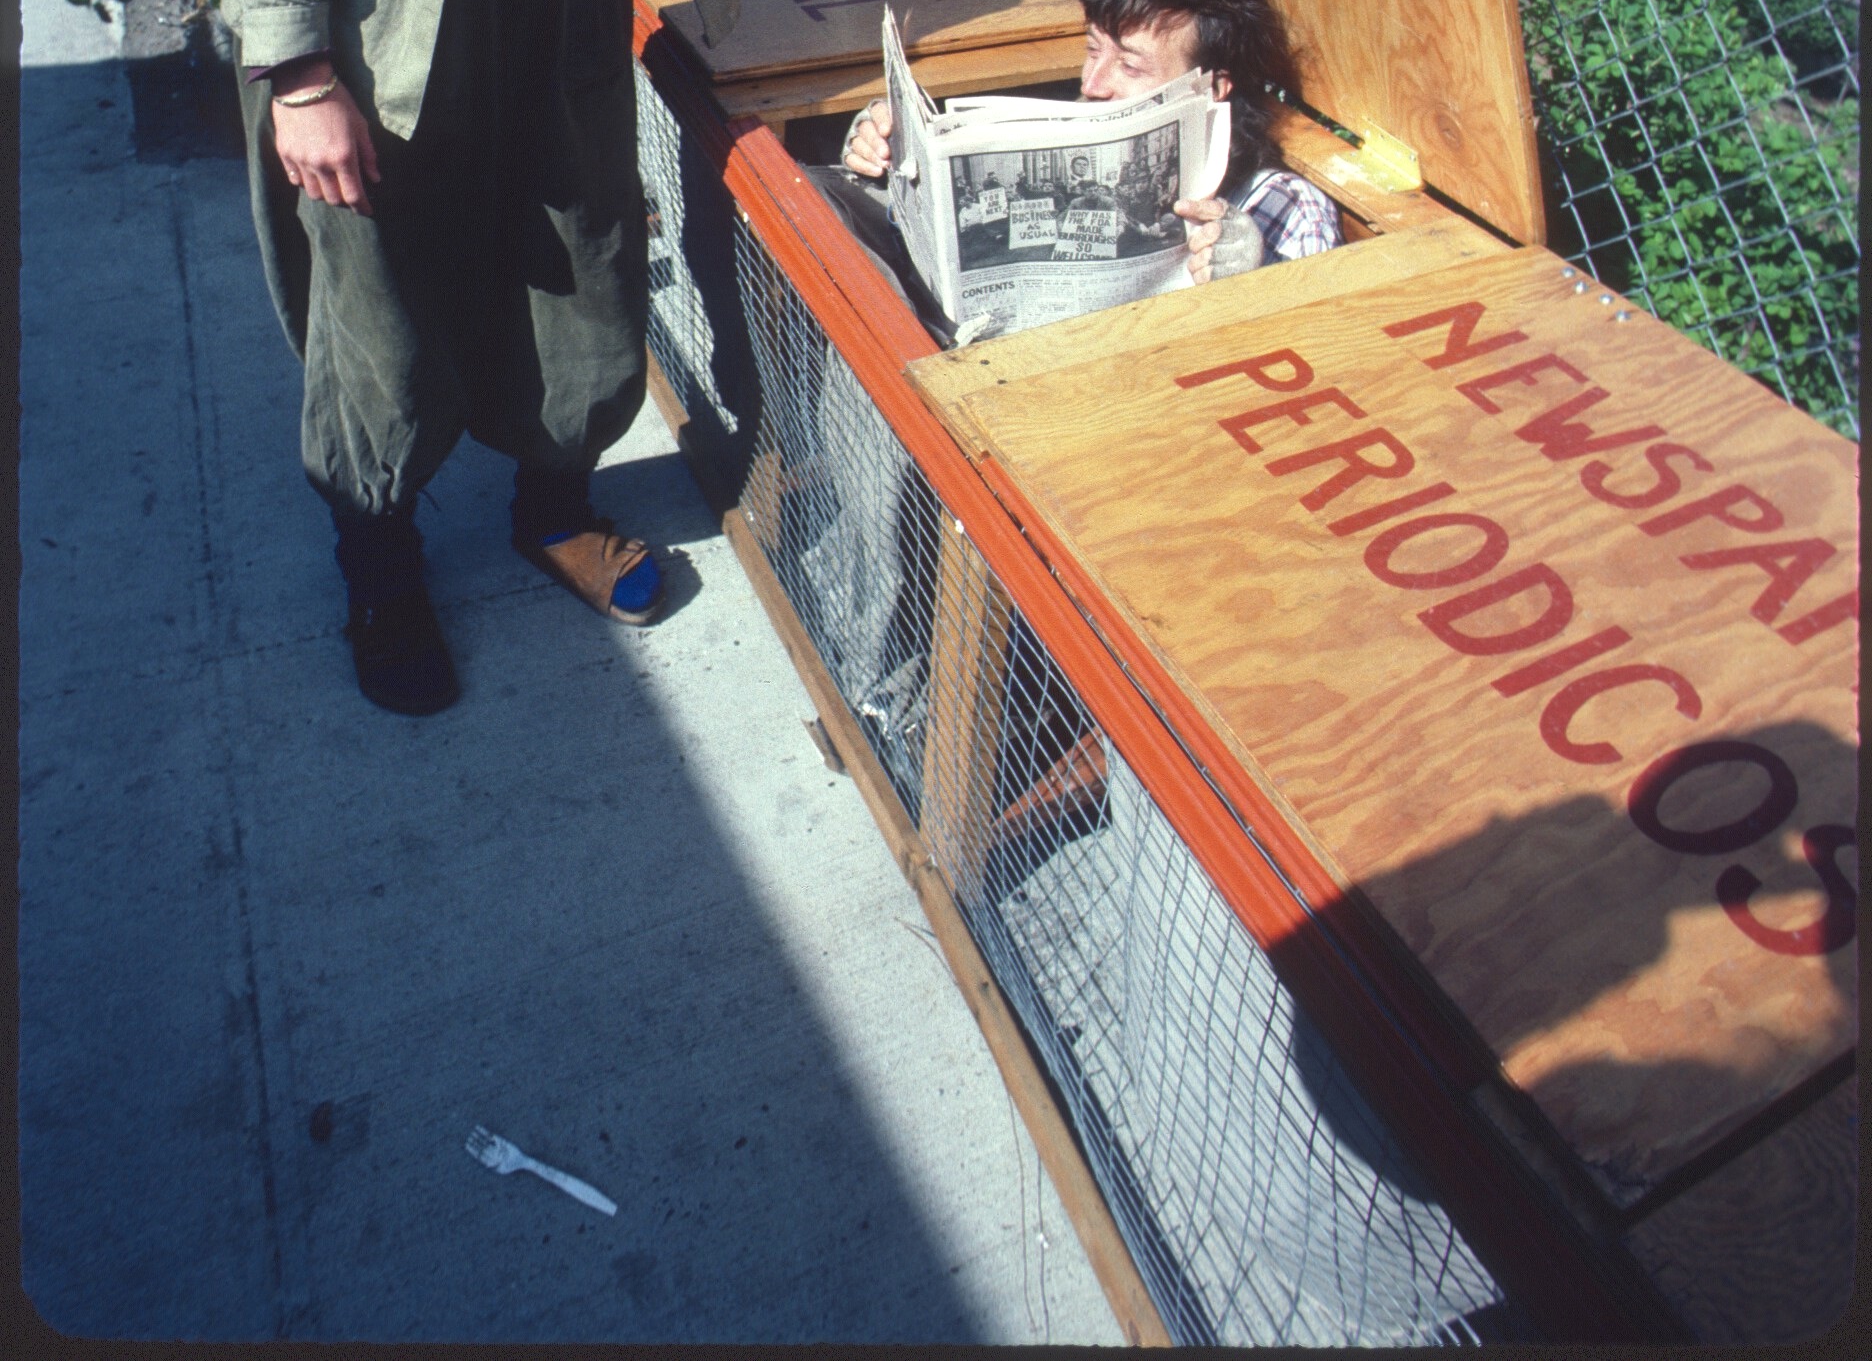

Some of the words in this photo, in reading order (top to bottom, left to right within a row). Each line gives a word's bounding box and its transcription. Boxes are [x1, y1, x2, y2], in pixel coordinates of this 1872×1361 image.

[1069, 211, 1090, 219] WHY
[1091, 211, 1112, 220] HAS
[1027, 221, 1041, 231] AS
[1068, 217, 1084, 225] THE
[1090, 218, 1111, 227] FDA
[1075, 225, 1103, 234] MADE
[1019, 230, 1056, 240] USUAL
[1052, 249, 1113, 260] WELLCO
[961, 280, 1016, 299] CONTENTS
[1174, 348, 1859, 957] PERIODICOS
